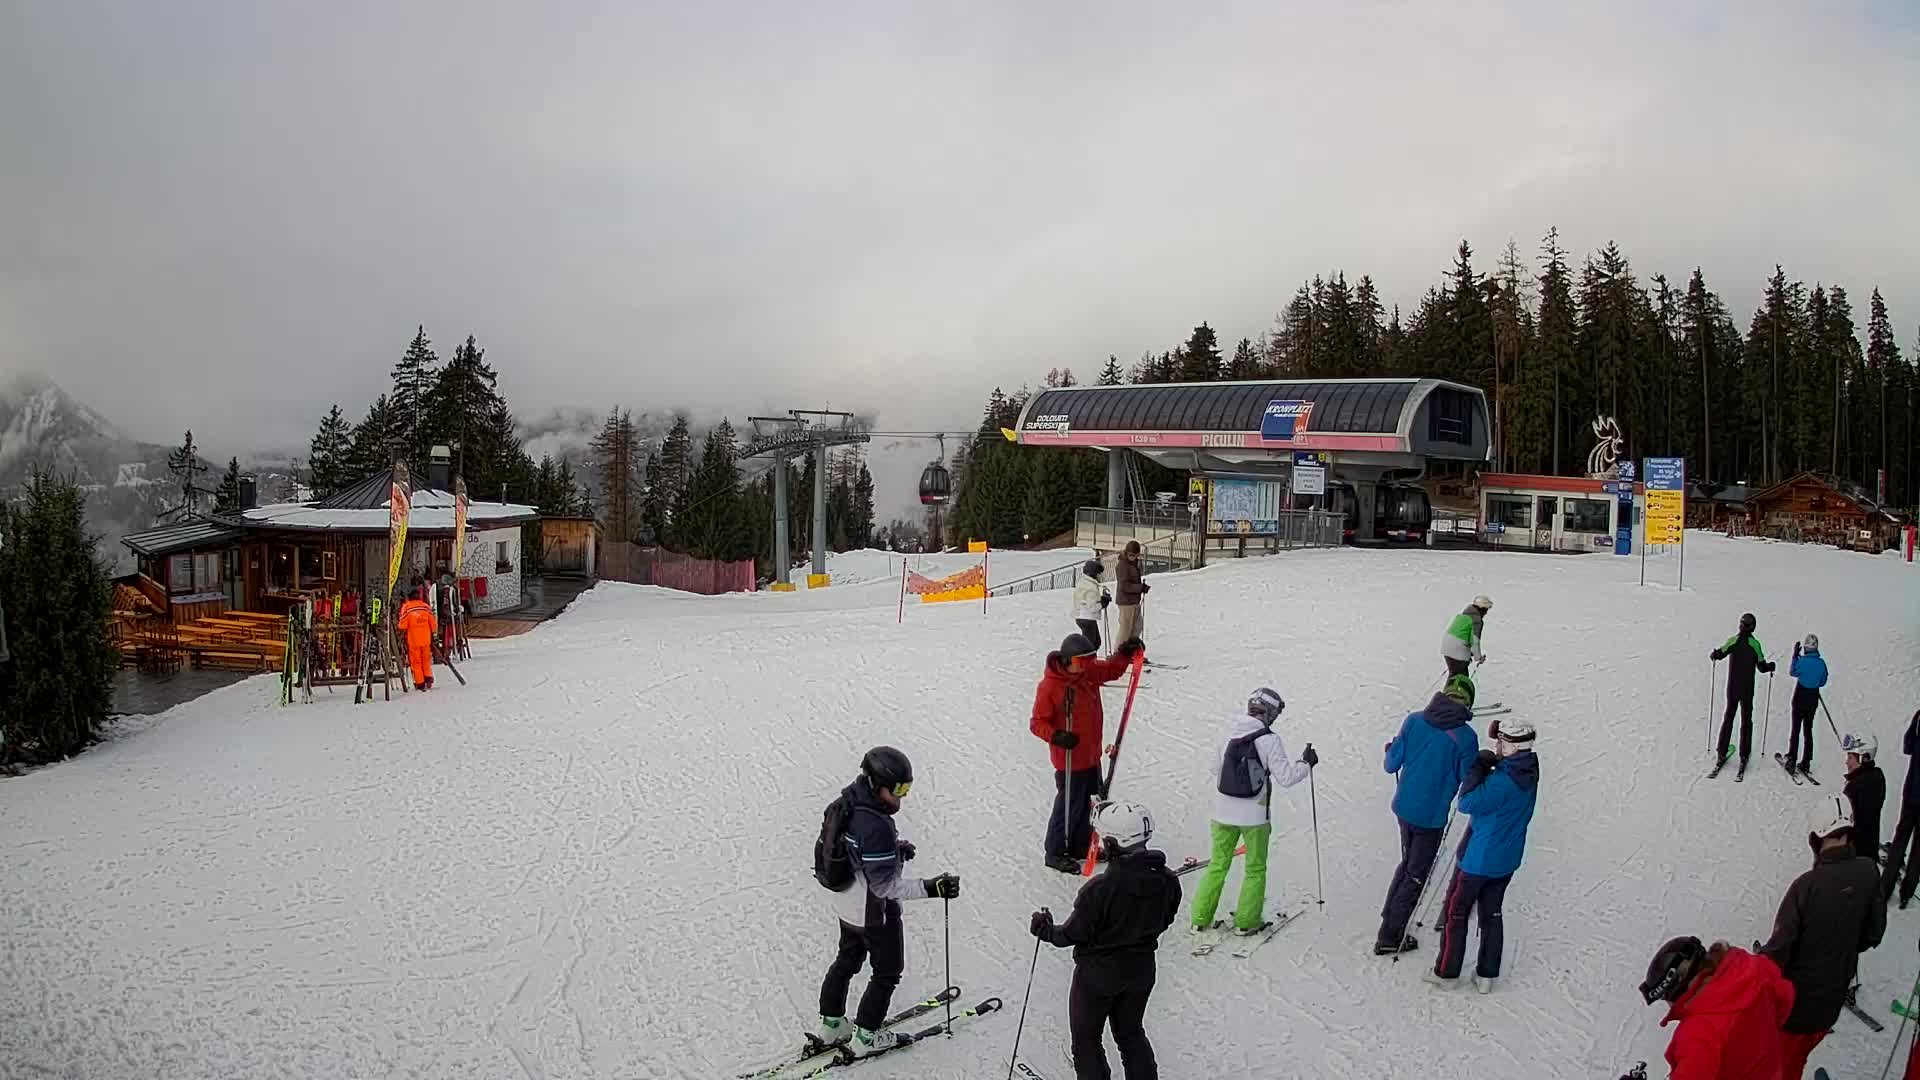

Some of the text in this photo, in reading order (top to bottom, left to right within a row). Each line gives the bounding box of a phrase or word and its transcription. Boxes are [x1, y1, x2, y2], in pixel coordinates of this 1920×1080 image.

[1036, 414, 1069, 422] DOLOMITI
[1026, 422, 1059, 430] SUPERSKI
[1202, 434, 1246, 447] PICULIN
[1648, 967, 1676, 998] GIRO
